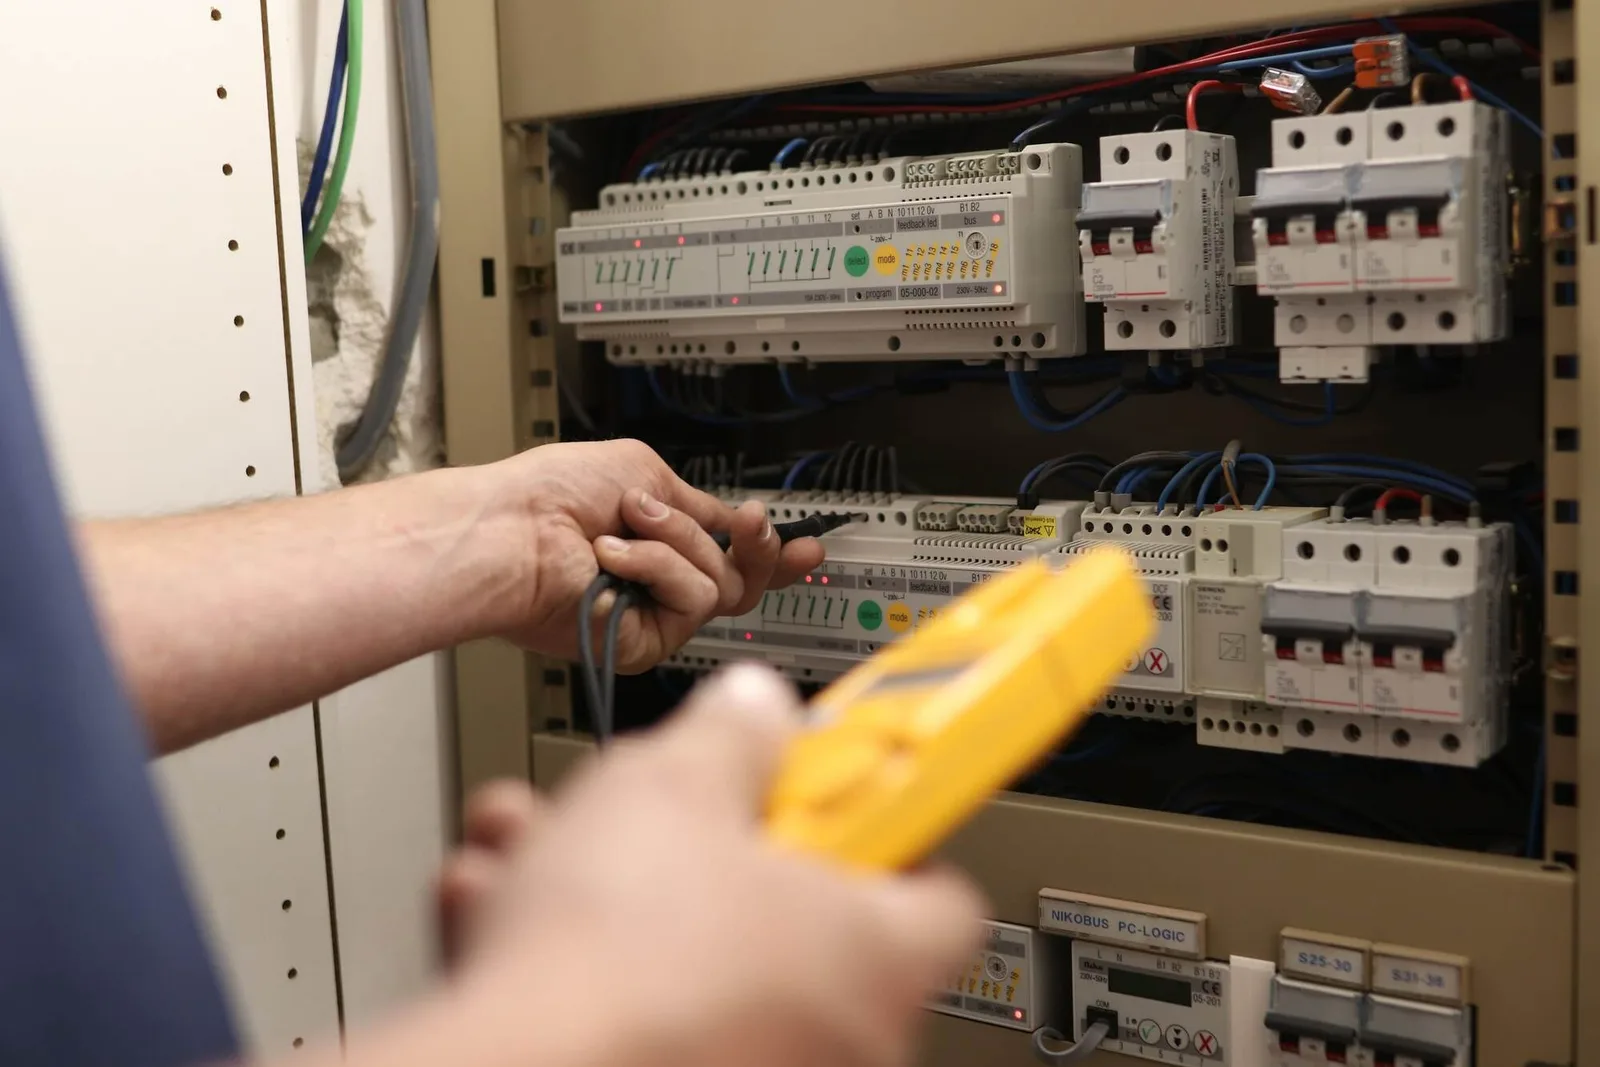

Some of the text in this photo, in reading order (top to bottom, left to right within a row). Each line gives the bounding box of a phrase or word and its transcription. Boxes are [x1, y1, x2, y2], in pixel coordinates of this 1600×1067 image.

[959, 201, 980, 213] B1 B2
[808, 215, 815, 224] 11
[824, 213, 832, 223] 12
[851, 211, 860, 222] set
[868, 210, 873, 219] A
[878, 209, 883, 219] B
[888, 208, 894, 218] N
[897, 207, 906, 217] 10
[907, 206, 915, 216] 11
[917, 206, 925, 216] 12
[964, 215, 977, 226] bus
[897, 216, 938, 230] feedback led
[905, 247, 914, 257] 11
[916, 246, 926, 257] 12
[927, 246, 936, 257] 13
[939, 245, 947, 256] 14
[950, 245, 959, 256] 15
[989, 242, 999, 253] 18
[877, 254, 896, 264] mode
[901, 264, 910, 277] m1
[913, 263, 922, 276] m2
[924, 262, 933, 276] m3
[935, 261, 943, 275] m4
[946, 260, 955, 275] m5
[960, 260, 969, 274] m6
[972, 259, 981, 274] m7
[986, 259, 995, 273] m8
[866, 288, 893, 301] program
[900, 286, 939, 298] 05-000-02
[974, 285, 989, 294] 50Hz
[864, 567, 873, 576] set
[881, 568, 886, 576] A
[891, 568, 896, 577] B
[900, 569, 906, 578] N
[910, 570, 918, 579] 10
[919, 571, 928, 580] 11
[929, 571, 938, 580] 12
[972, 573, 980, 583] B1
[910, 581, 938, 592] feedback
[1152, 583, 1169, 594] DCF
[889, 611, 908, 623] mode
[1051, 909, 1185, 943] NIKOBUS PC-LOGIC
[1097, 947, 1123, 963] L N
[1156, 957, 1182, 973] B1 B2
[1299, 952, 1352, 972] S25-30
[1194, 966, 1221, 981] B1 B2
[1095, 999, 1110, 1009] COM
[1193, 993, 1222, 1008] 05-201
